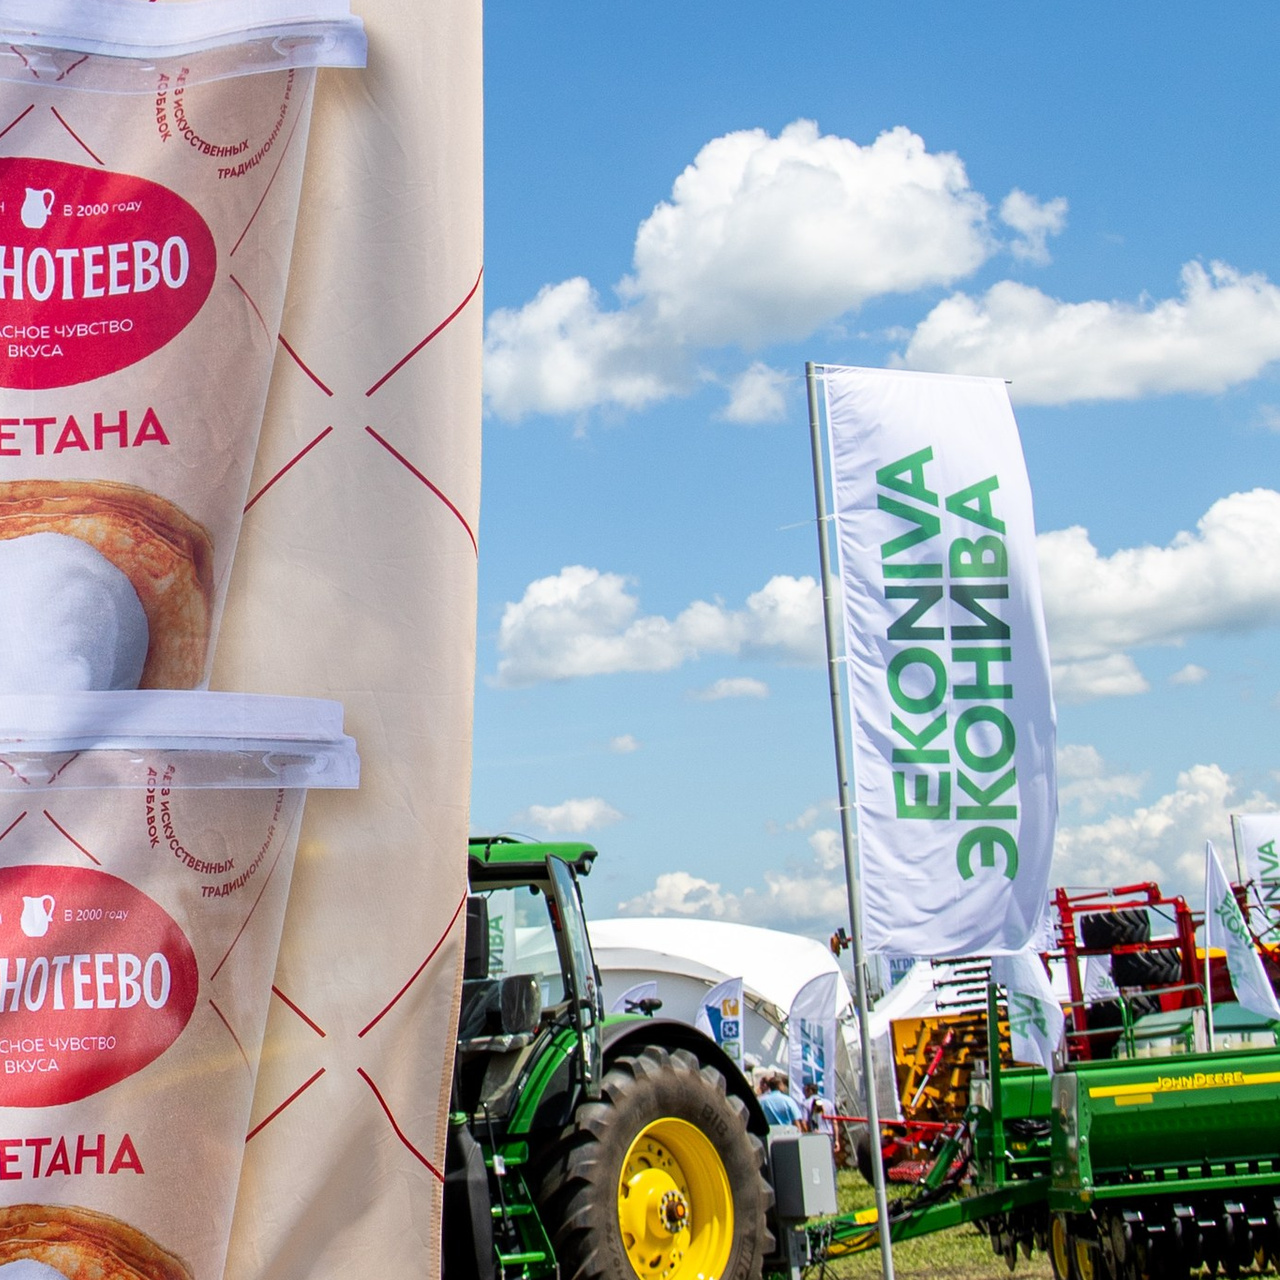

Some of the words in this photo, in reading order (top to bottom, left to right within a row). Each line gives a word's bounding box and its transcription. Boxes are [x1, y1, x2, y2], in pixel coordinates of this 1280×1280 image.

[173, 98, 250, 158] ИСКУССТВЕННЫХ
[218, 104, 288, 180] ТРАДИЦИОННЫЙ
[63, 204, 73, 217] В
[76, 202, 109, 217] 2000
[54, 318, 134, 338] ЧУВСТВО
[8, 344, 64, 359] ВКУСА
[876, 446, 950, 821] EKONIVA
[945, 475, 1019, 882] ЭКОНИВА
[160, 801, 235, 874] ИСКУССТВЕННЫХ
[201, 825, 276, 898] ТРАДИЦИОННЫЙ
[64, 909, 72, 921] В
[76, 908, 103, 921] 2000
[48, 1036, 117, 1052] ЧУВСТВО
[4, 1058, 60, 1074] ВКУСА
[1155, 1076, 1193, 1091] JOHN
[1193, 1071, 1245, 1088] DEERE
